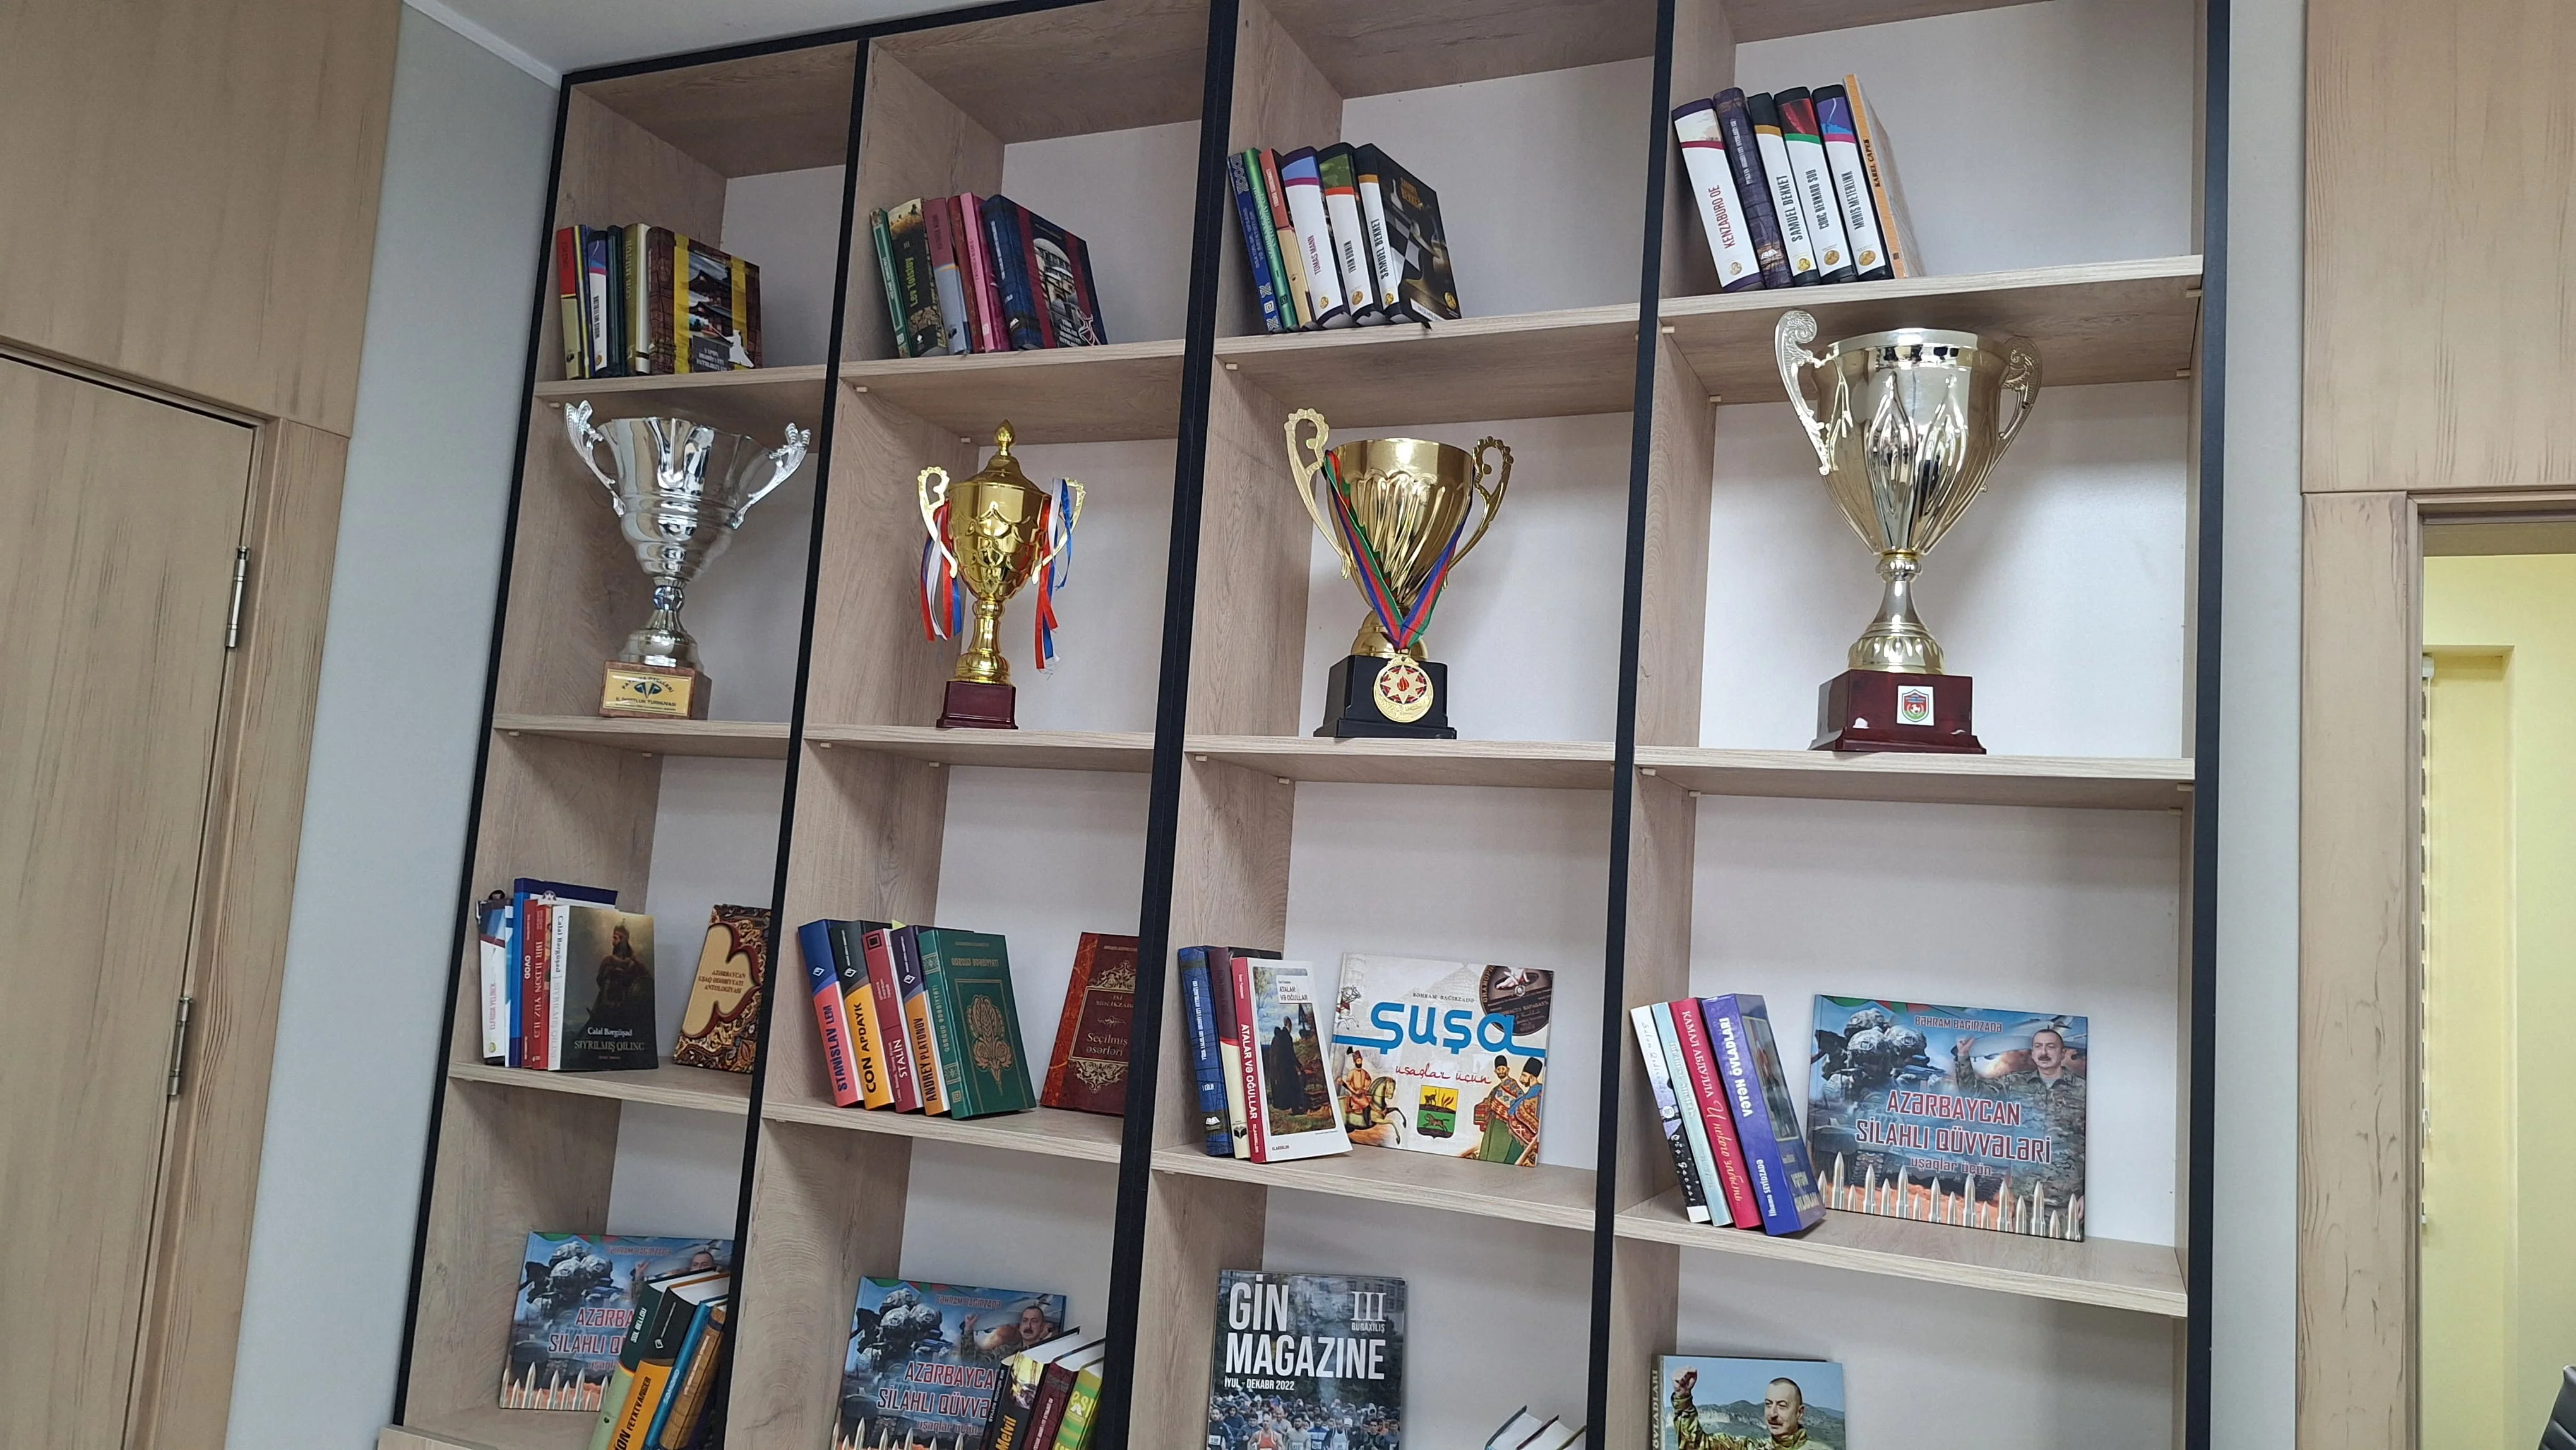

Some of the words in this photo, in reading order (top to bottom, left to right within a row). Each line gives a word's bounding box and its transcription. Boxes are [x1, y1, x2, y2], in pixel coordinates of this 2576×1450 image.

[1707, 184, 1722, 198] OE
[1776, 175, 1795, 207] BEKKET
[1867, 162, 1880, 188] KAREL
[1711, 198, 1735, 249] KENZABURO
[1784, 207, 1803, 242] SAMUEL
[1816, 210, 1830, 230] CORC
[1306, 235, 1316, 253] MANN
[905, 257, 917, 288] Tolstoy
[1311, 253, 1321, 275] TOMAS
[1376, 248, 1389, 280] SAMUEL
[909, 289, 919, 308] Lev
[587, 1027, 603, 1035] Calal
[824, 1004, 835, 1028] LEM
[852, 1002, 870, 1060] APDAYK
[1915, 1016, 1951, 1028] BƏHRAM
[914, 1017, 930, 1062] PLATONOV
[1241, 1024, 1252, 1058] ATALAR
[1682, 1010, 1700, 1048] КАМАЛ
[1692, 1048, 1714, 1098] АБДУЛЛА
[1721, 1017, 1743, 1077] ÖVLADLARI
[828, 1031, 847, 1093] STANİSLAV
[893, 1039, 908, 1078] STALİN
[1243, 1060, 1253, 1073] VƏ
[863, 1066, 877, 1094] CON
[920, 1063, 938, 1102] ANDREY
[1244, 1074, 1257, 1119] OĞULLAR
[1737, 1079, 1753, 1117] VƏTƏN
[1887, 1090, 2021, 1126] AZƏRBAYCAN
[1856, 1117, 1929, 1149] SİLAHLI
[1936, 1127, 2051, 1164] QÜVVƏLƏRİ
[1911, 1158, 1957, 1173] uşaqlar
[1962, 1165, 1993, 1176] üçün
[576, 1308, 634, 1328] AZƏRBA
[1229, 1274, 1289, 1332] GİN
[1351, 1291, 1387, 1322] III
[1351, 1322, 1386, 1334] BURAXILIŞ
[1225, 1333, 1386, 1380] MAGAZINE
[904, 1361, 996, 1389] AZƏRBAYCA
[1246, 1379, 1274, 1389] DEKABR
[1275, 1381, 1295, 1391] 2022
[878, 1387, 934, 1413] SİLAHLI
[938, 1392, 991, 1419] QÜVVƏ
[995, 1415, 1017, 1450] Melvil
